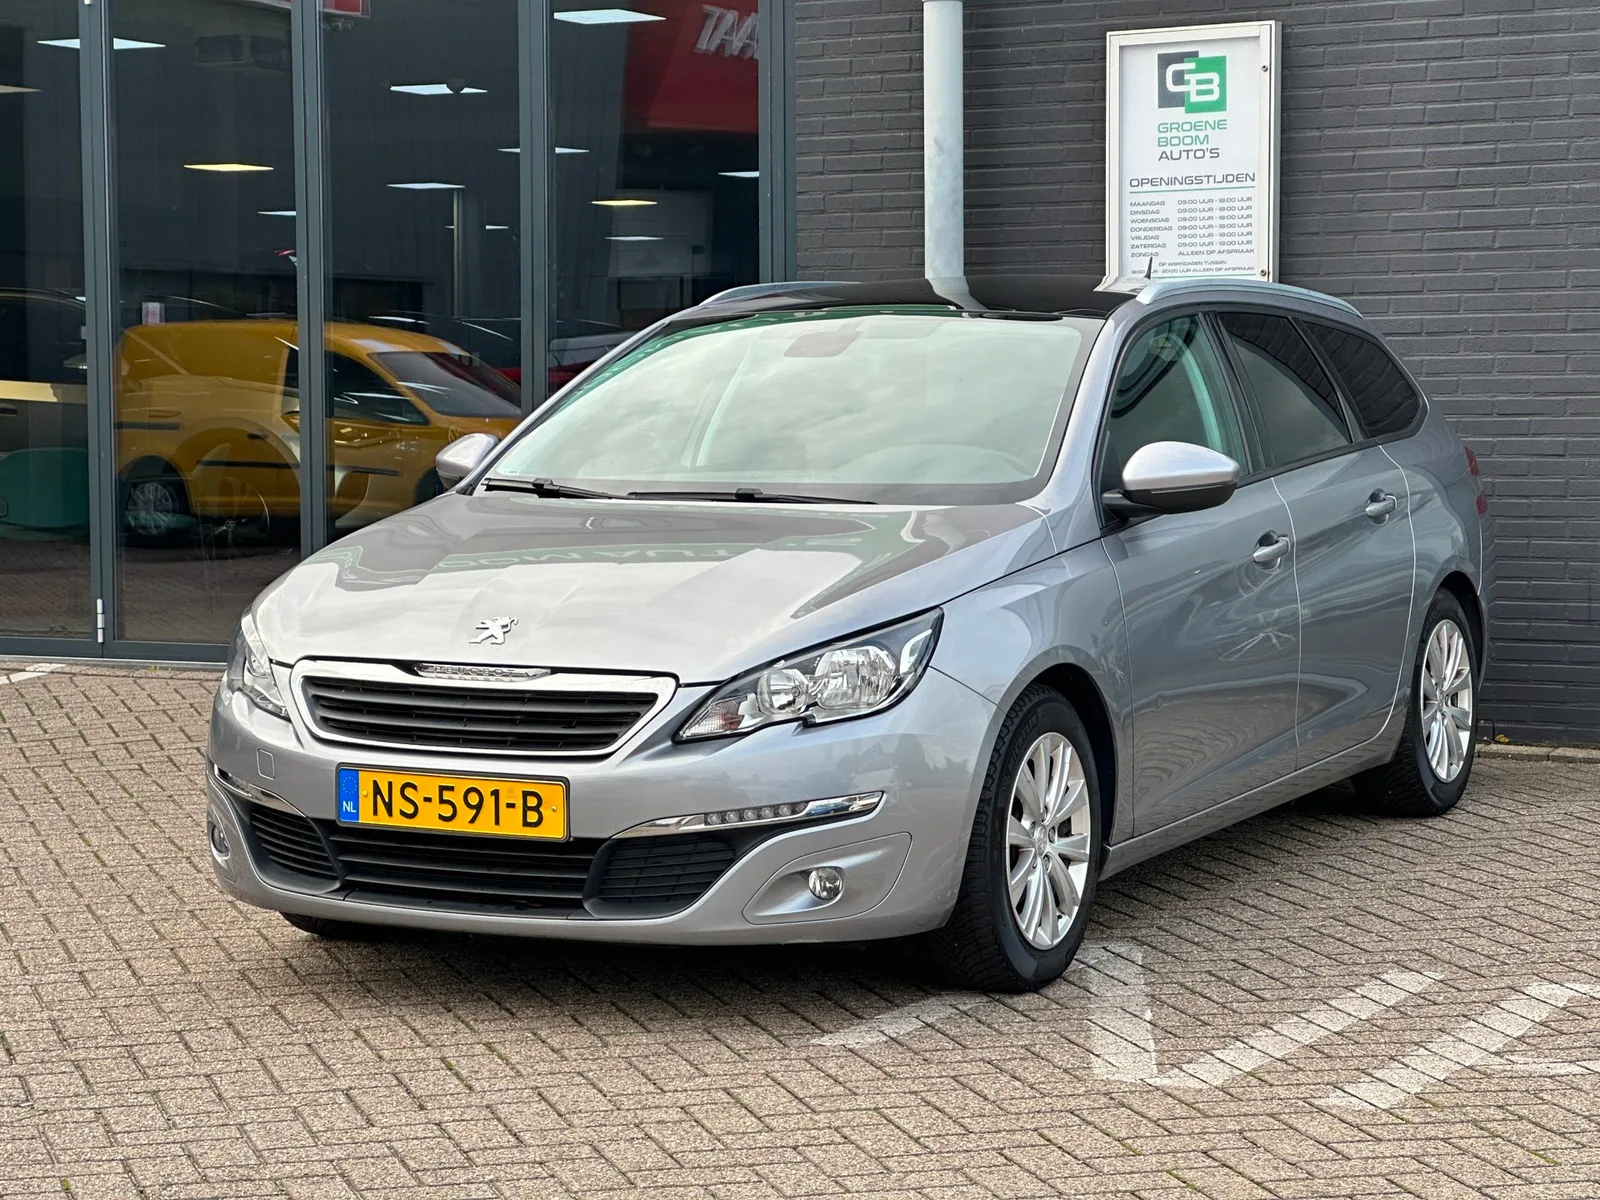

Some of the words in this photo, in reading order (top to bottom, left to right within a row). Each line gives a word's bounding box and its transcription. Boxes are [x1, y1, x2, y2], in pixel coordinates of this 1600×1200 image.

[1157, 119, 1228, 134] GROENE
[1157, 134, 1210, 148] BOOM
[1158, 147, 1220, 162] AUTO'S
[1129, 172, 1256, 188] OPENINGSTIJDEN
[342, 800, 357, 813] NL
[372, 779, 544, 828] NS-591-B
